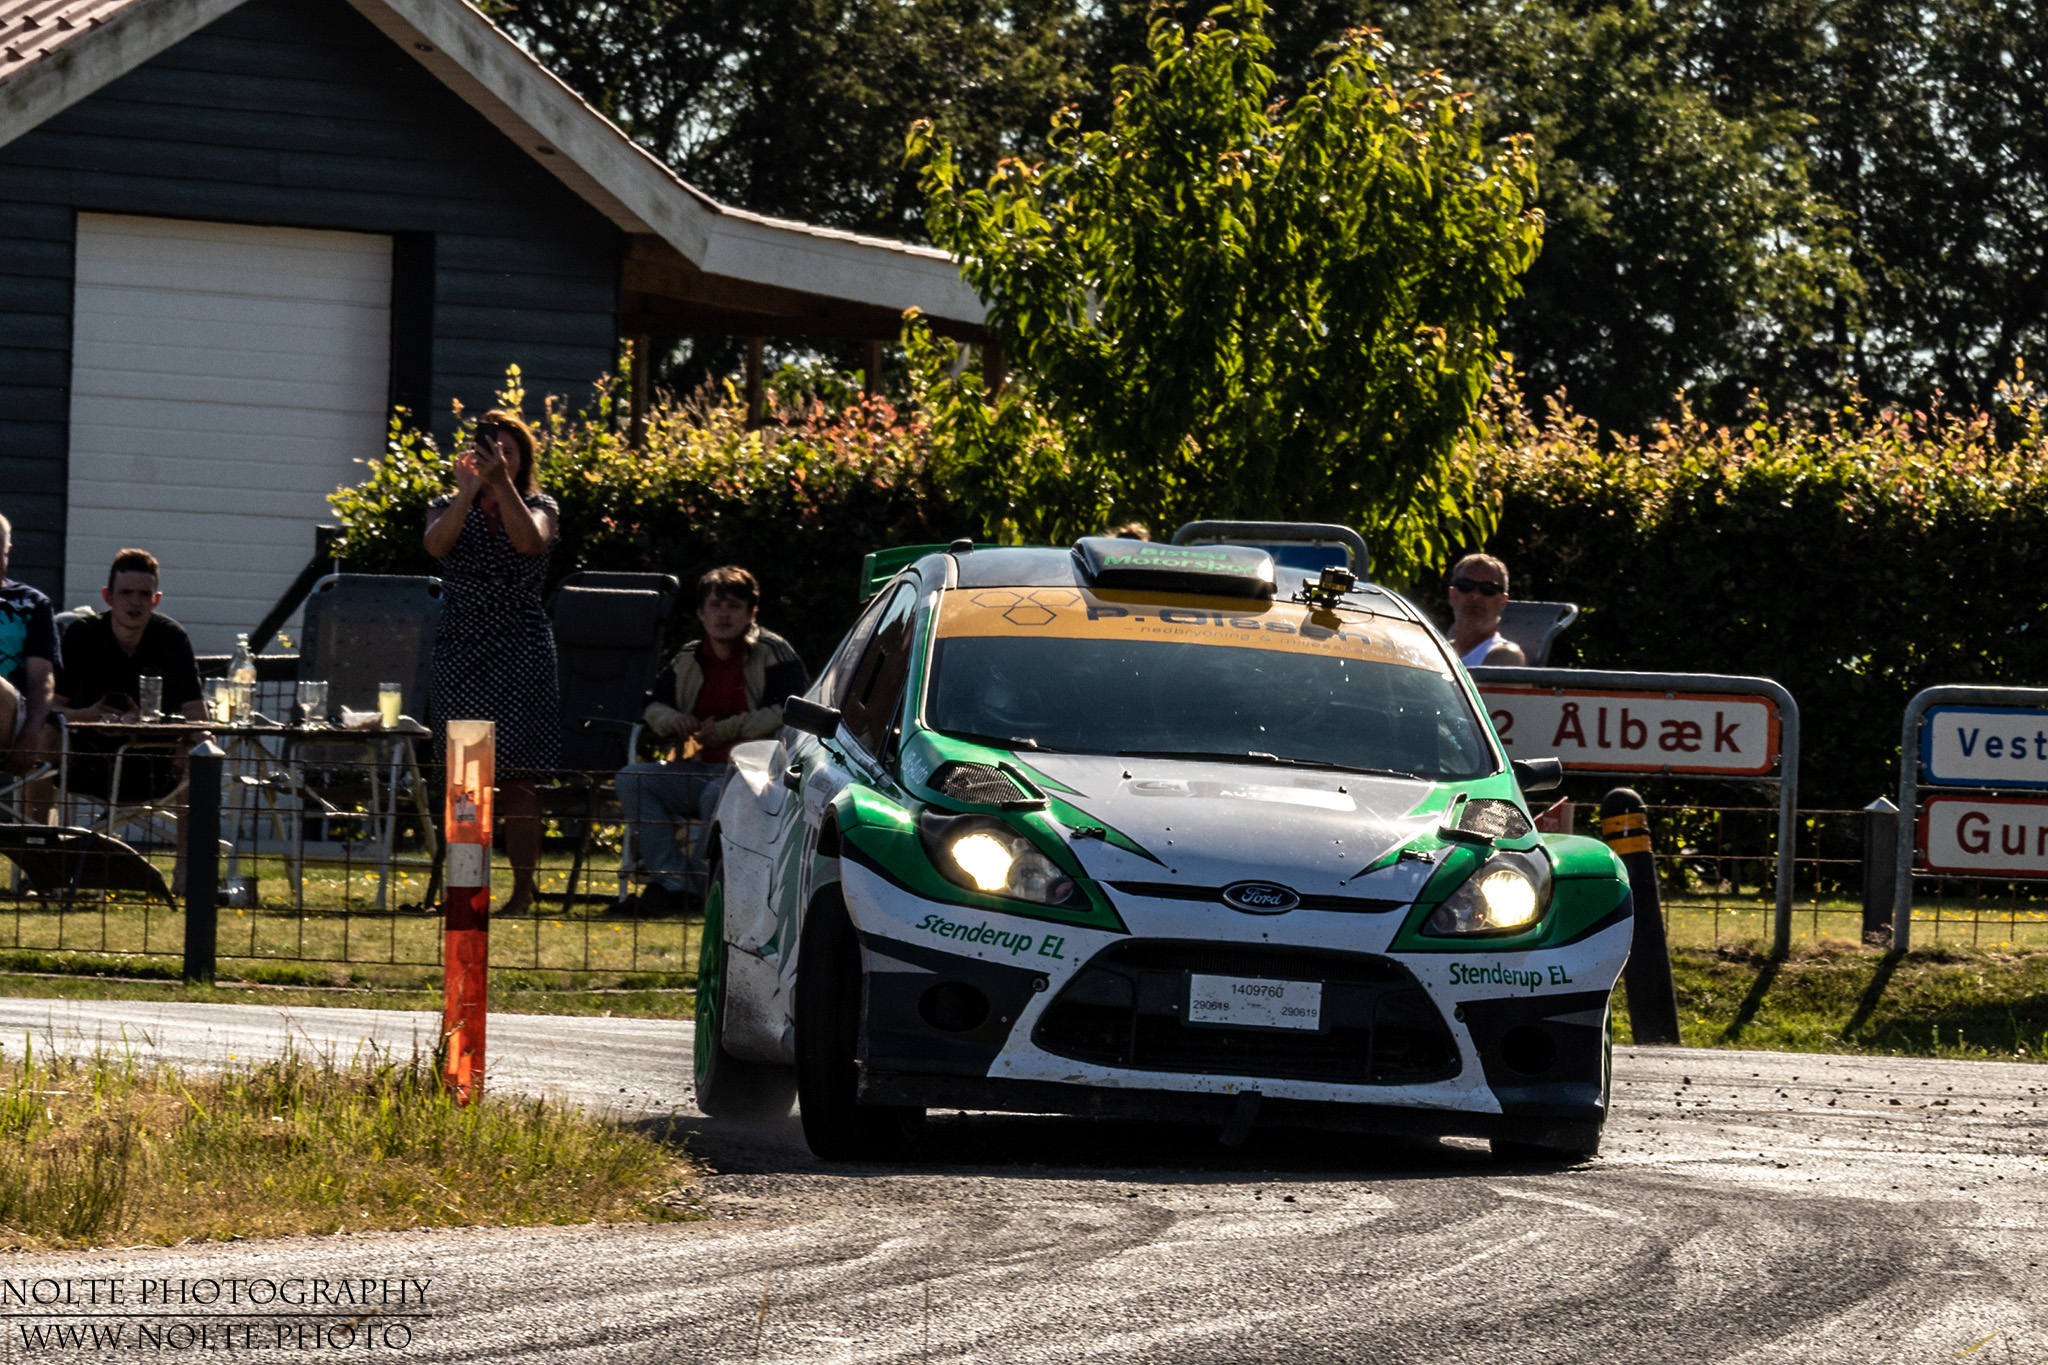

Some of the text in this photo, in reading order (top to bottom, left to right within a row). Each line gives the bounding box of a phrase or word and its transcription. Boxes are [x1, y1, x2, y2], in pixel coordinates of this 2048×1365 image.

[1140, 547, 1227, 561] Bisted
[1103, 555, 1264, 575] Motorspor
[1086, 606, 1145, 622] P.
[1490, 702, 1742, 754] 2 Ålbæk
[1957, 727, 2048, 761] Vest
[1241, 886, 1283, 906] Ford
[915, 914, 1065, 960] Stenderup EL
[1449, 962, 1573, 993] Stenderup EL
[1231, 983, 1285, 998] 1409760
[1192, 1000, 1318, 1018] 290619 290619
